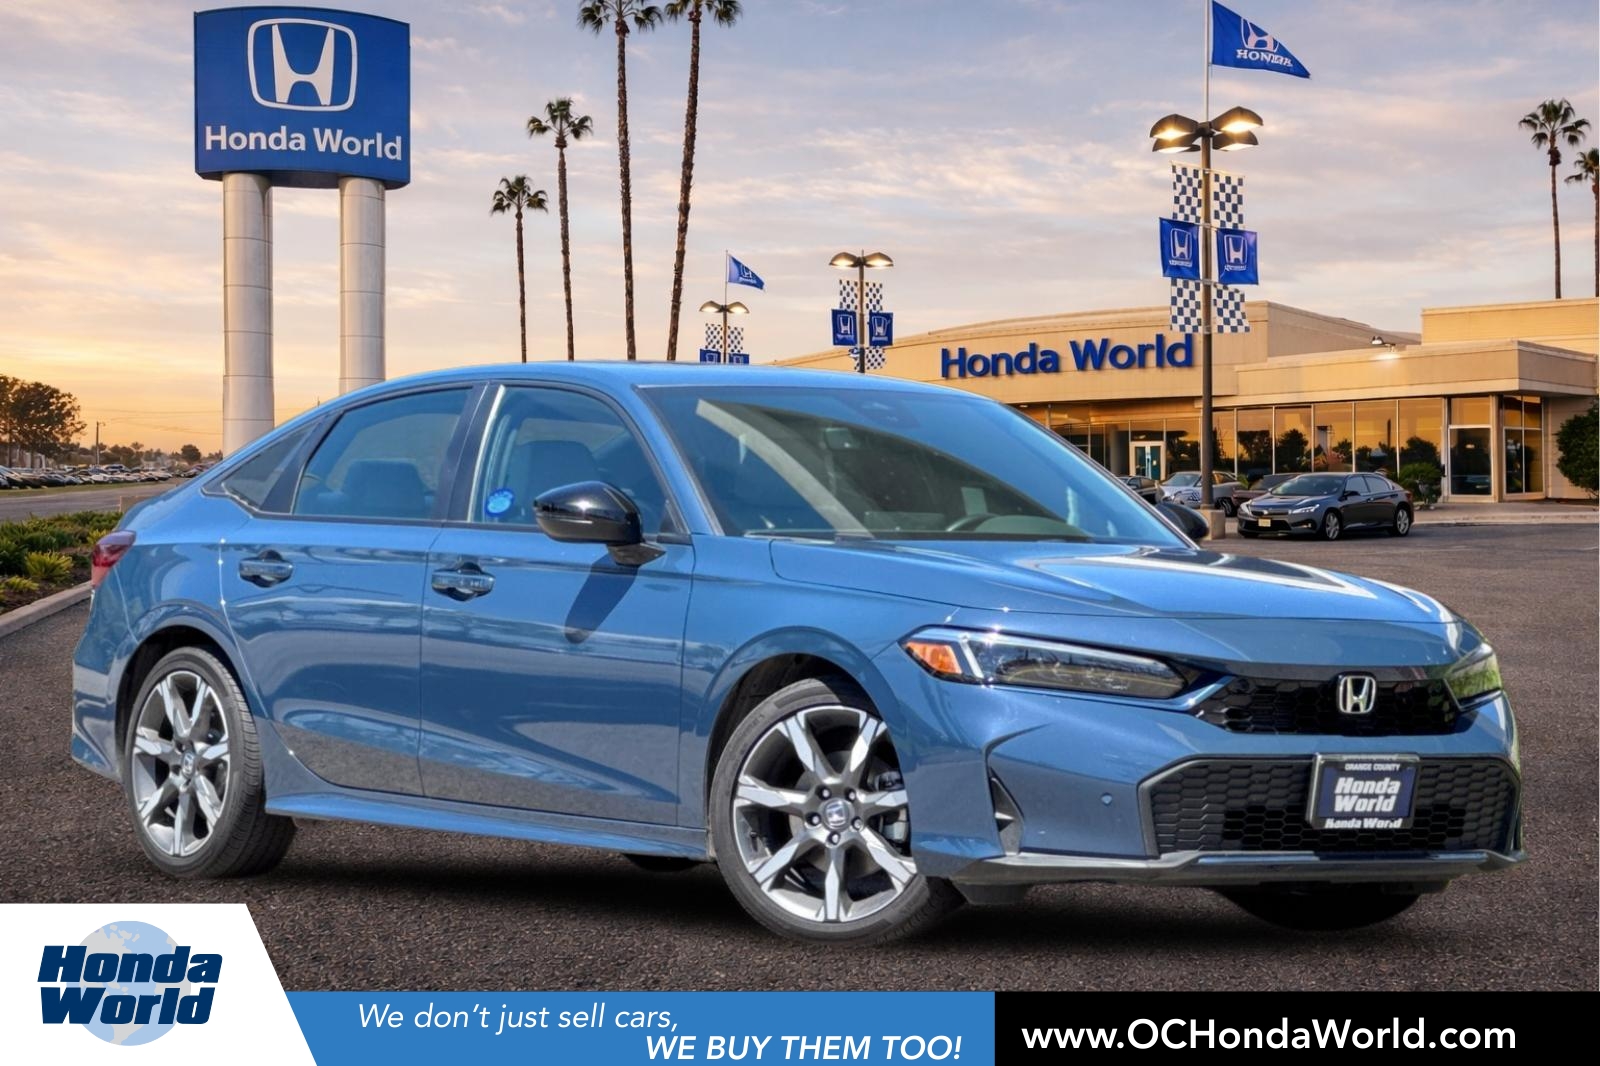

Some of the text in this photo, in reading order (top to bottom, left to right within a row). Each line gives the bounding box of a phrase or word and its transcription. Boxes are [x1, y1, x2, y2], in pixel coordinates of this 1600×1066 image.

[205, 125, 402, 160] Honda World
[941, 332, 1195, 379] Honda World
[1344, 763, 1401, 771] ORANGE COUNTY
[1334, 777, 1401, 794] Honda
[1334, 795, 1397, 812] World
